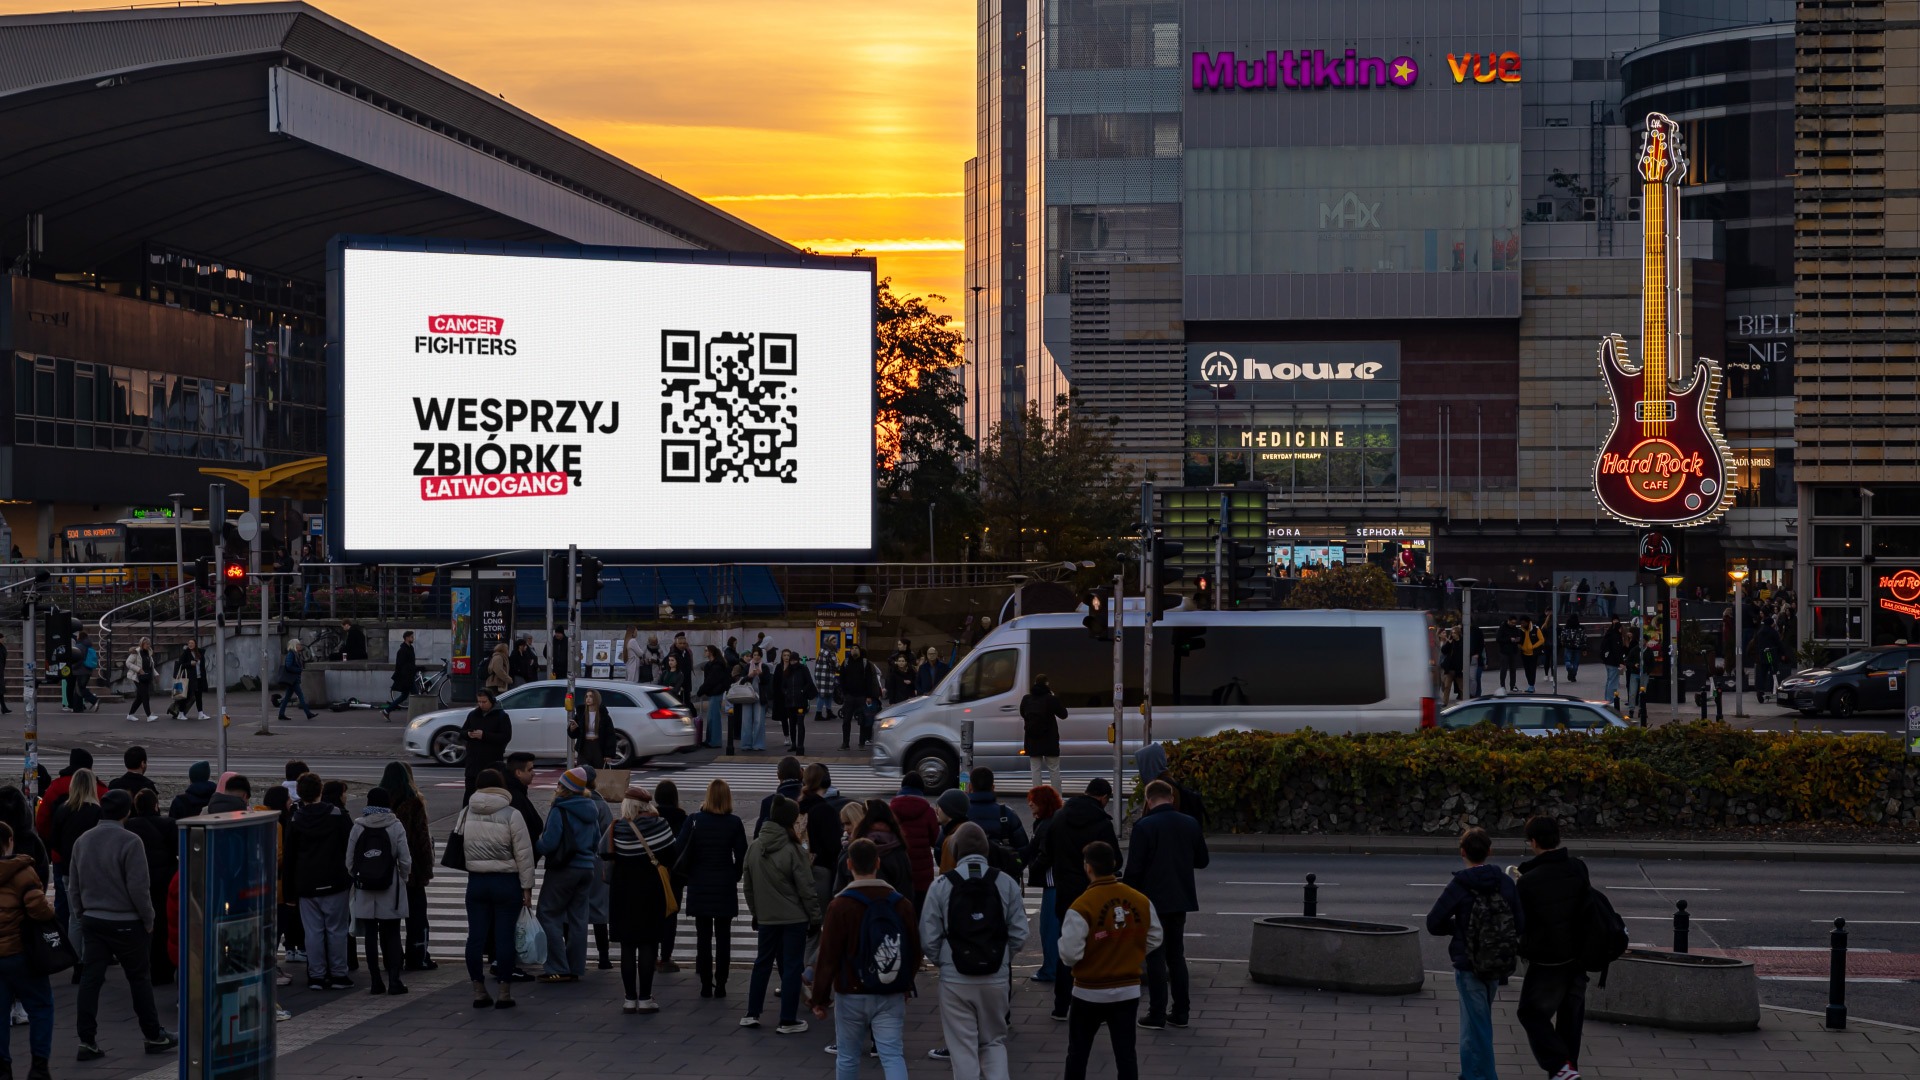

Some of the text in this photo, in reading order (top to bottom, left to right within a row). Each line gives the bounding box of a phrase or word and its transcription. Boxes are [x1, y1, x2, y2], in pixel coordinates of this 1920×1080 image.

[1192, 48, 1418, 89] Multikino
[1319, 190, 1382, 229] MAX
[434, 318, 497, 332] CANCER
[415, 336, 517, 356] FIGHTERS
[1748, 342, 1788, 362] NIE
[1243, 358, 1383, 380] house
[412, 397, 619, 434] WESPRZYJ
[1241, 431, 1344, 447] MEDICINE
[413, 434, 582, 487] ZBIÓRKĘ
[1602, 451, 1704, 478] Hard Rock
[425, 475, 563, 497] ŁATWOGANG
[1642, 480, 1669, 489] CAFE
[67, 529, 79, 538] 504
[1268, 528, 1301, 536] HORA
[1356, 528, 1405, 536] SEPHORA
[1879, 576, 1920, 590] Hard Ro
